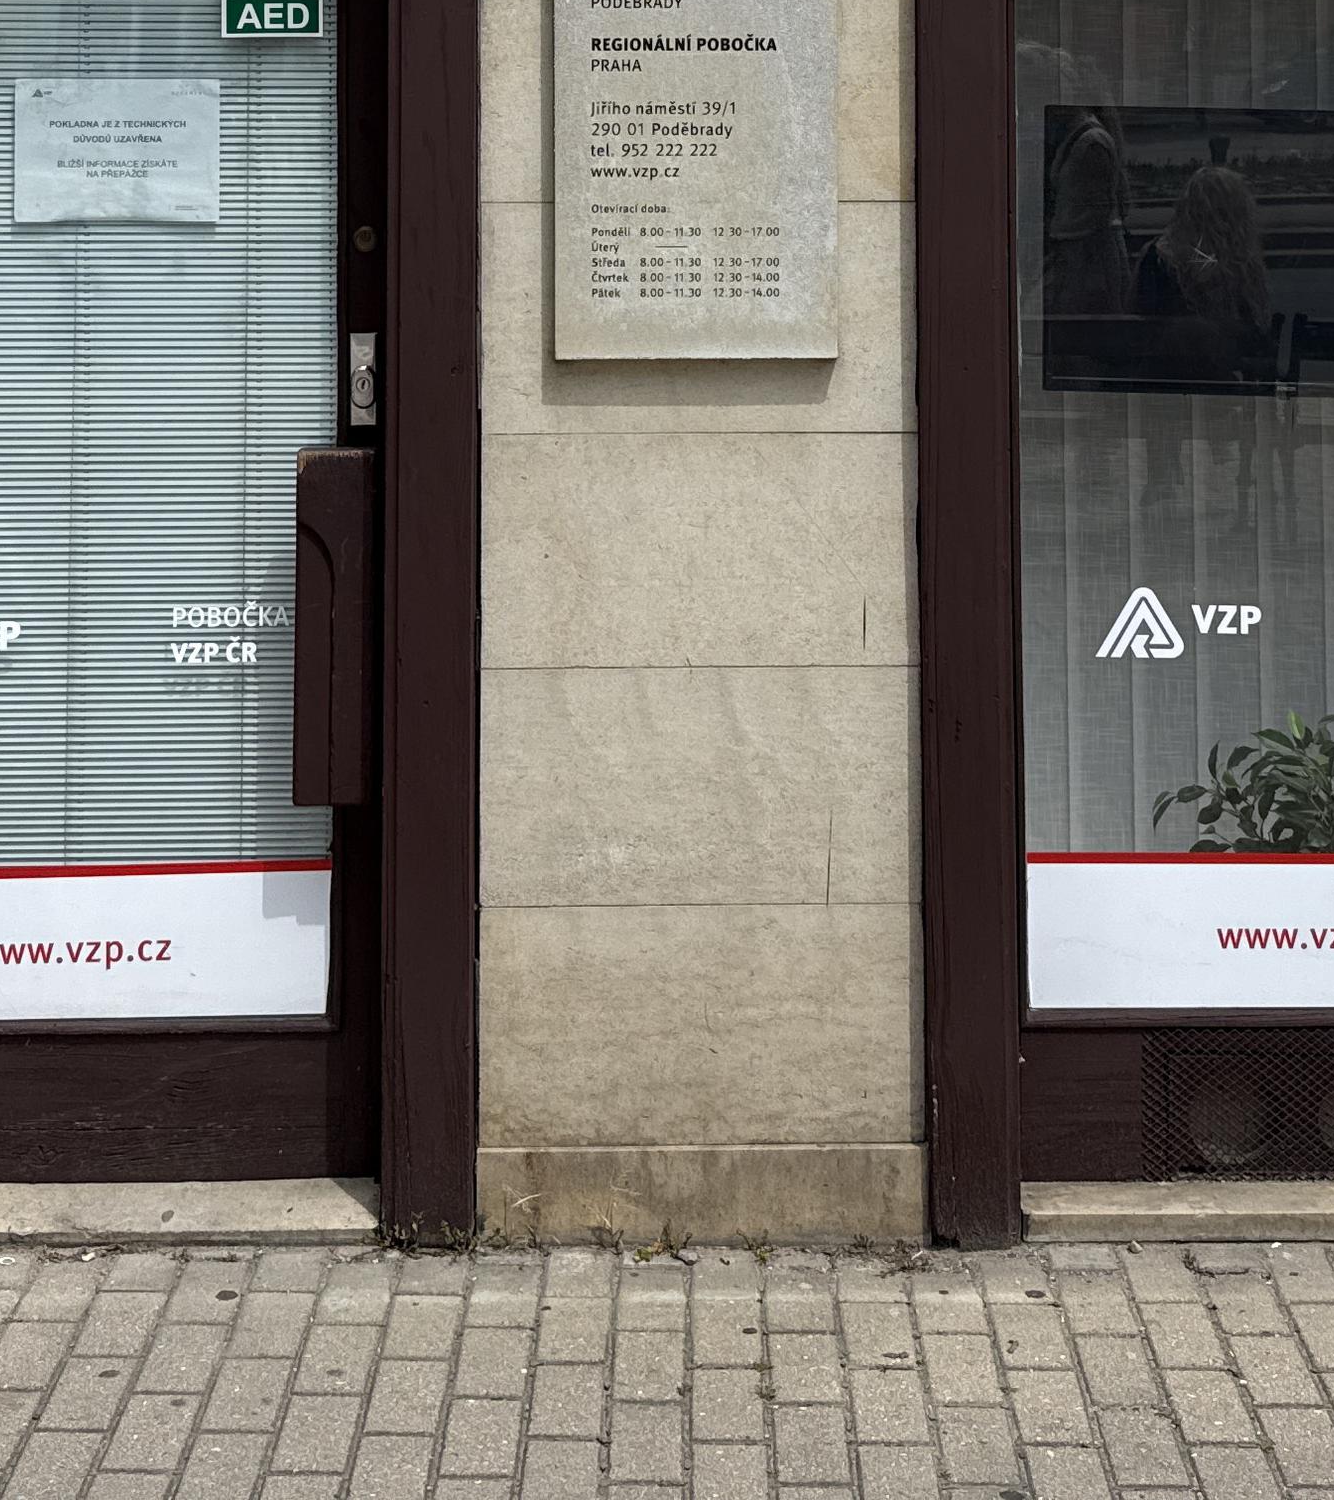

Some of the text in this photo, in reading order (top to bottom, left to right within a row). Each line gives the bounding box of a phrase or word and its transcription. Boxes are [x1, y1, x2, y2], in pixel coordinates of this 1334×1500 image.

[236, 2, 310, 29] AED
[591, 33, 777, 52] REGIONÁLNÍ POBOČKA
[591, 59, 642, 73] PRAHA
[590, 100, 737, 117] Jiřího náměstí 39/1
[49, 118, 187, 128] POKLADNA JE Z TECHNICKÝCH
[591, 122, 733, 139] 290 01 Poděbrady
[113, 134, 162, 143] UZAVŘENA
[621, 143, 648, 157] 952
[656, 143, 683, 157] 222
[690, 143, 718, 157] 222
[86, 159, 139, 168] INFORMACE
[86, 170, 99, 178] NA
[172, 600, 290, 628] POBOČKA
[1191, 604, 1262, 635] VZP
[170, 635, 258, 664] VZP ČR
